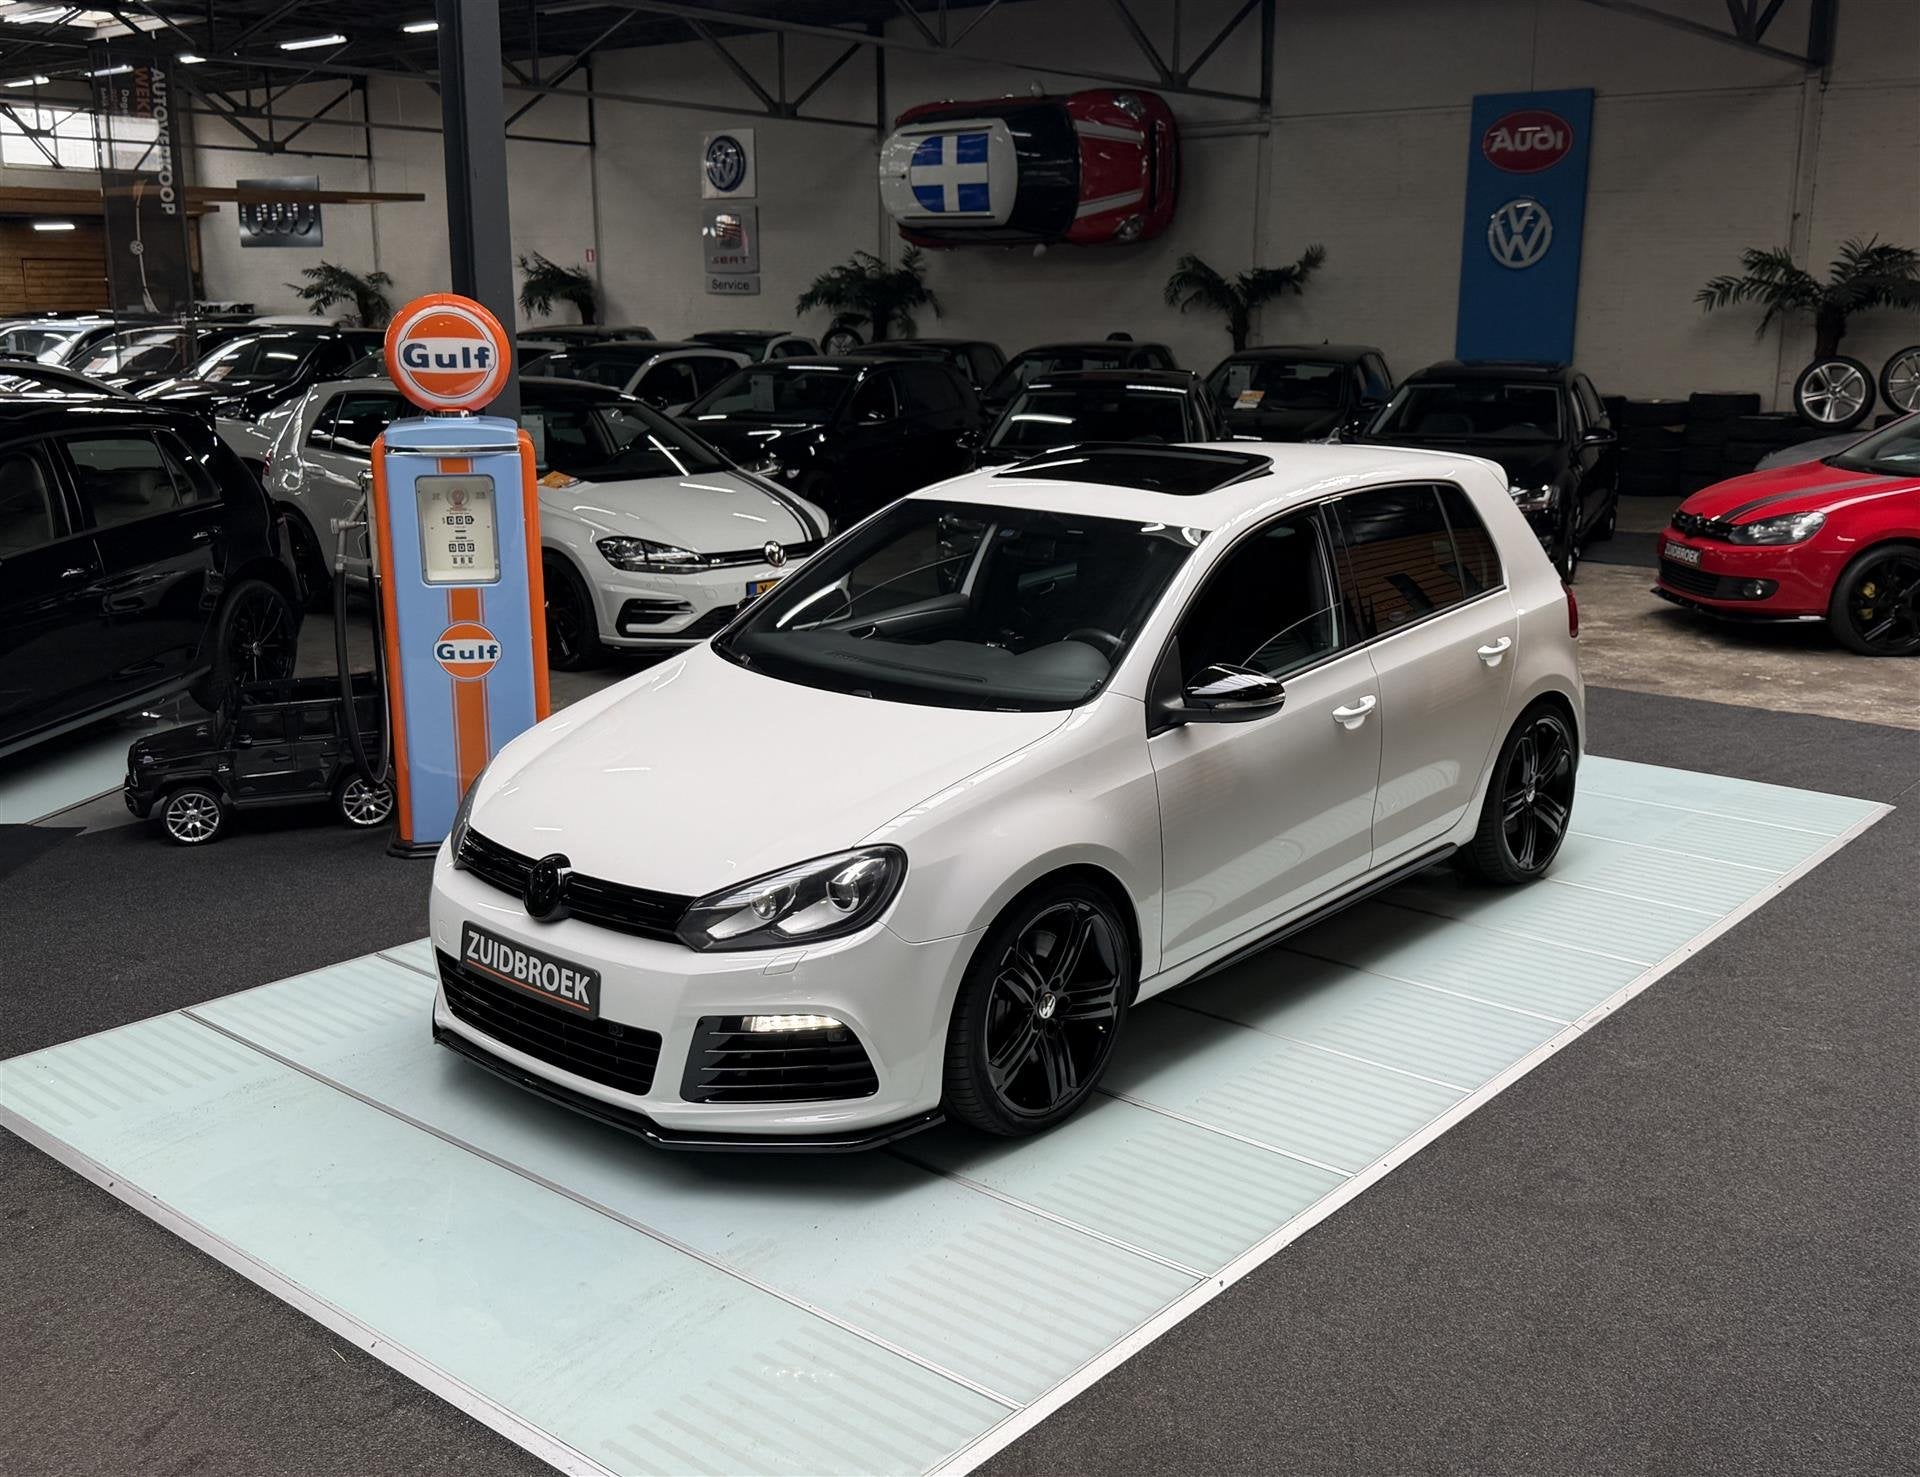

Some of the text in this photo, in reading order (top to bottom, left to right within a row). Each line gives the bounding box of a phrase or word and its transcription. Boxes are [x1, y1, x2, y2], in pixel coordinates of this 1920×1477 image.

[151, 68, 176, 215] AUTOVERKOOP
[712, 278, 750, 290] Service
[403, 343, 490, 369] Gulf
[436, 643, 498, 660] Gulf
[466, 930, 590, 1005] ZUIDBROEK
